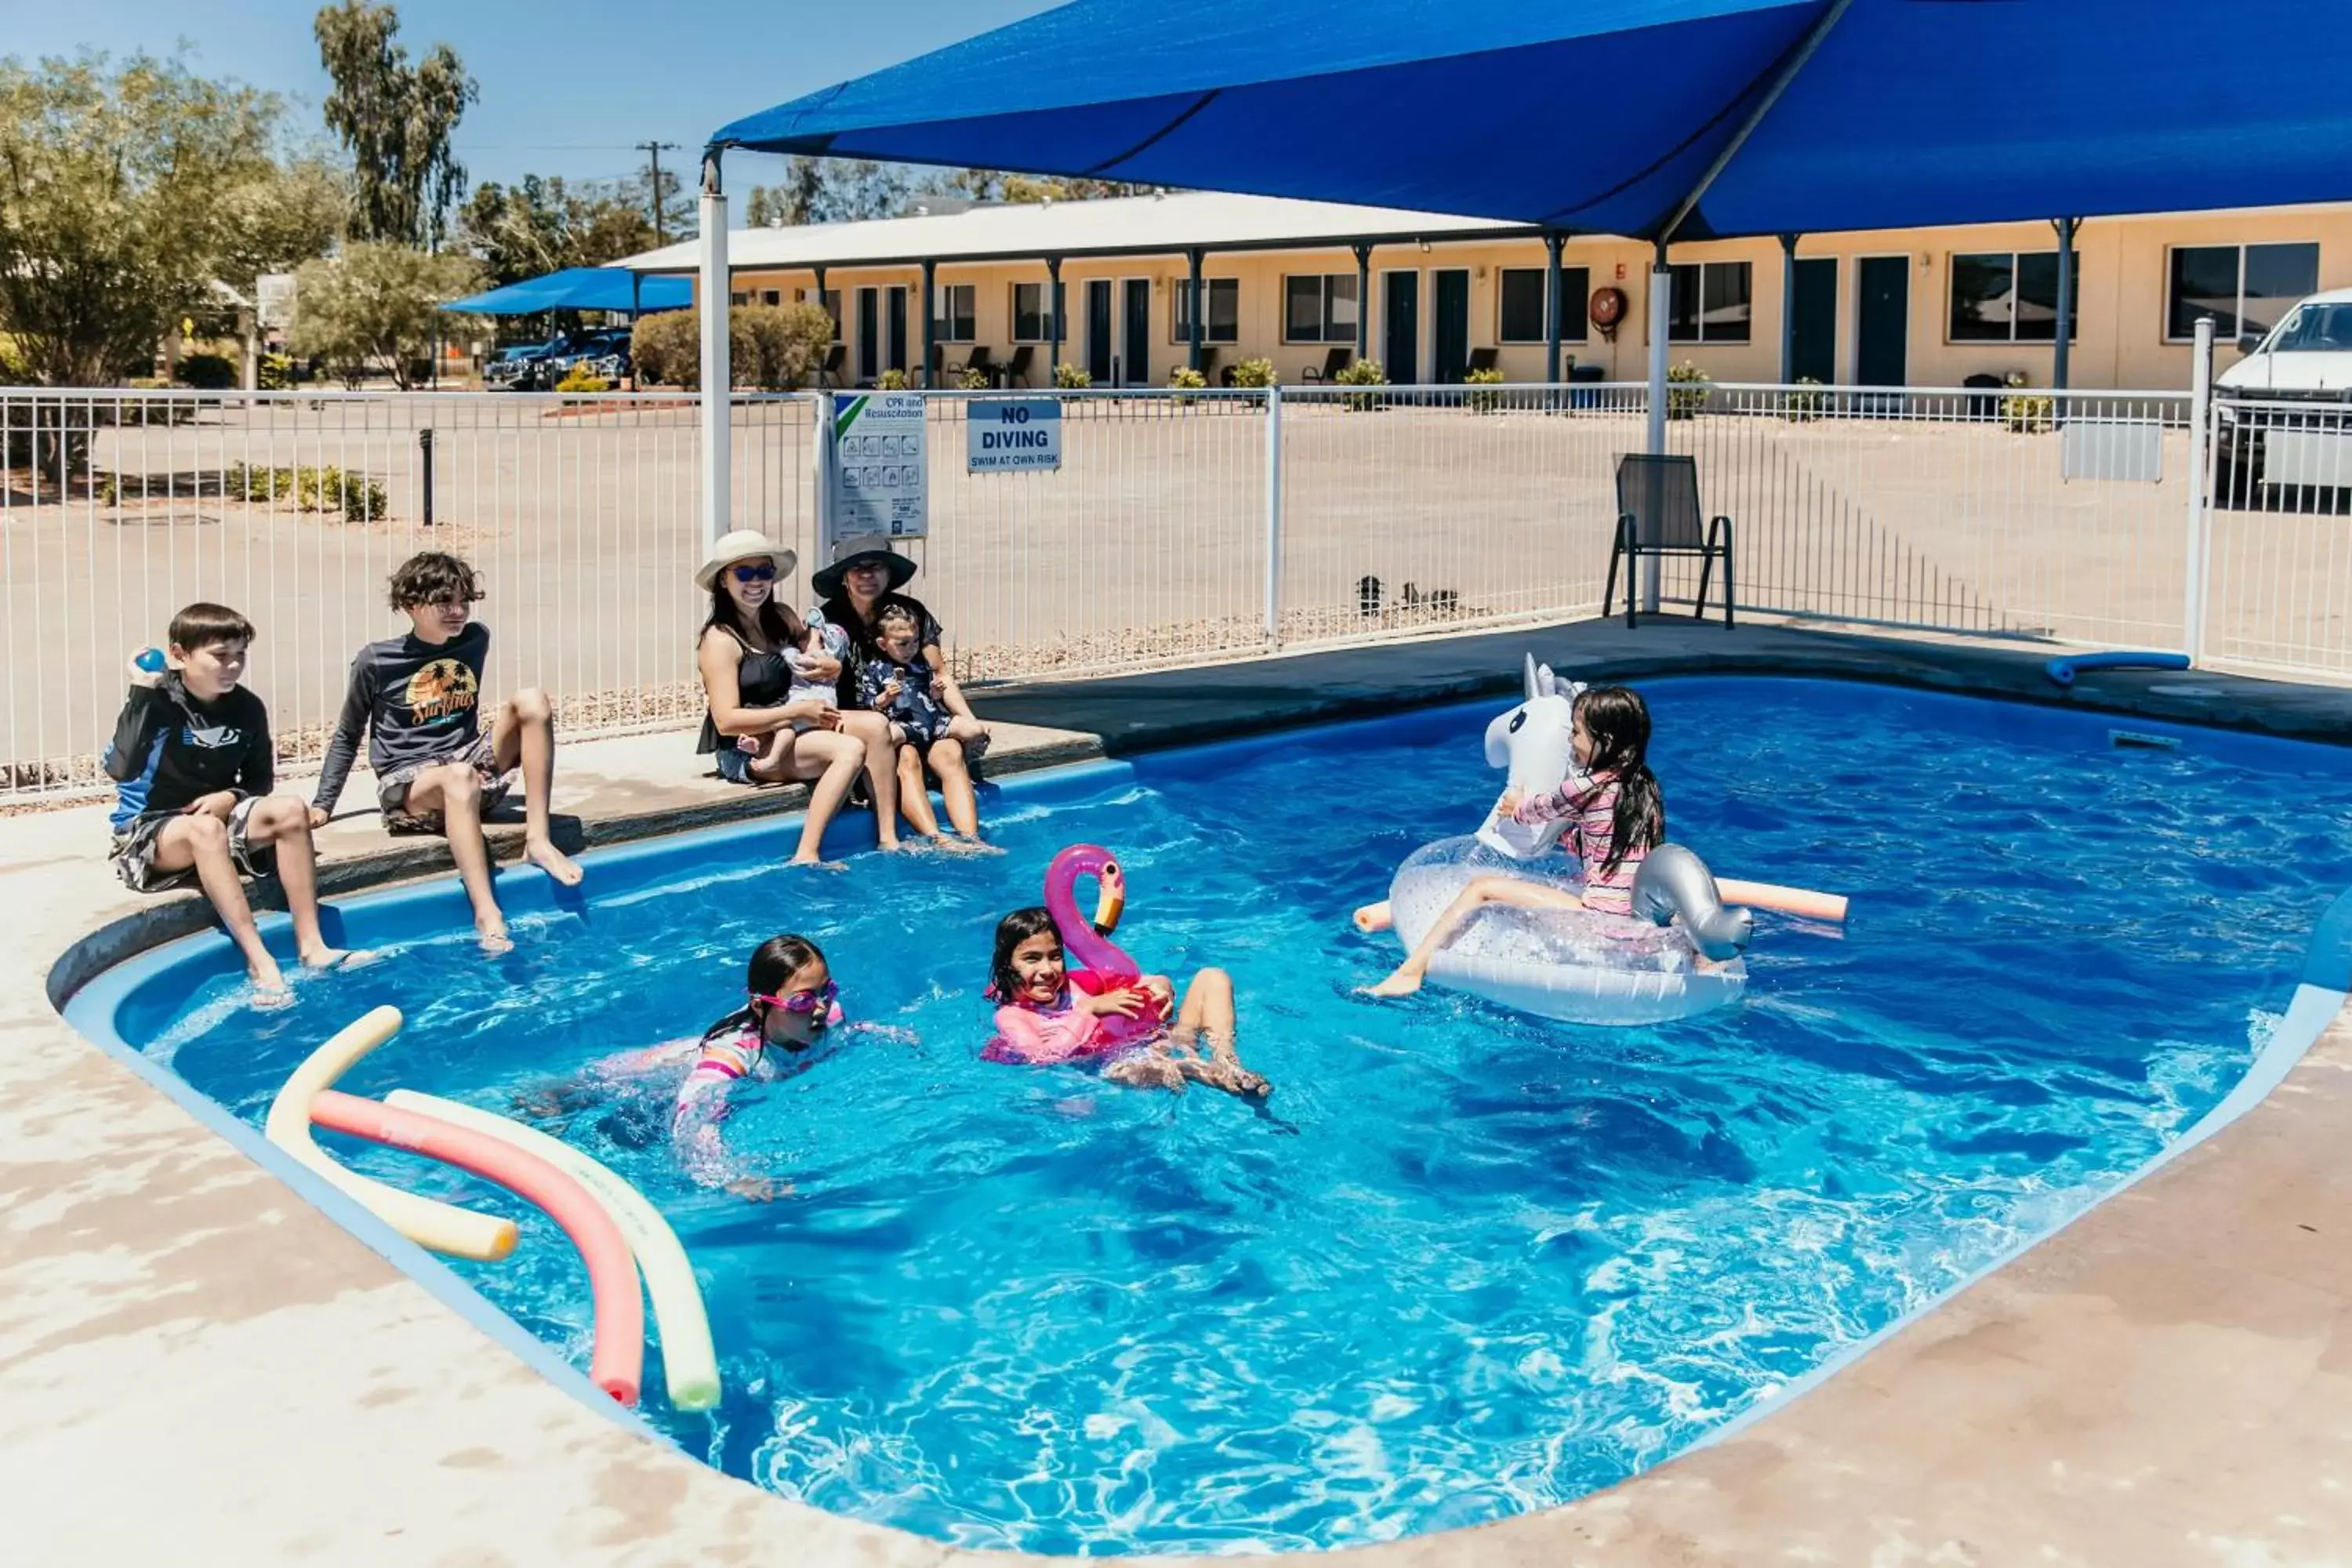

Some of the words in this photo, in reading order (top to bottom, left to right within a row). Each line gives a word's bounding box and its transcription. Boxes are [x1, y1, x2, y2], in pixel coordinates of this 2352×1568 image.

[886, 397, 904, 407] CPR
[906, 396, 923, 407] and
[865, 408, 923, 418] Resuscitation
[1002, 406, 1029, 424] NO
[982, 430, 1048, 449] DIVING
[971, 456, 996, 466] SWIM
[1000, 456, 1011, 465] AT
[1013, 455, 1035, 465] OWN
[1037, 453, 1058, 464] RISK
